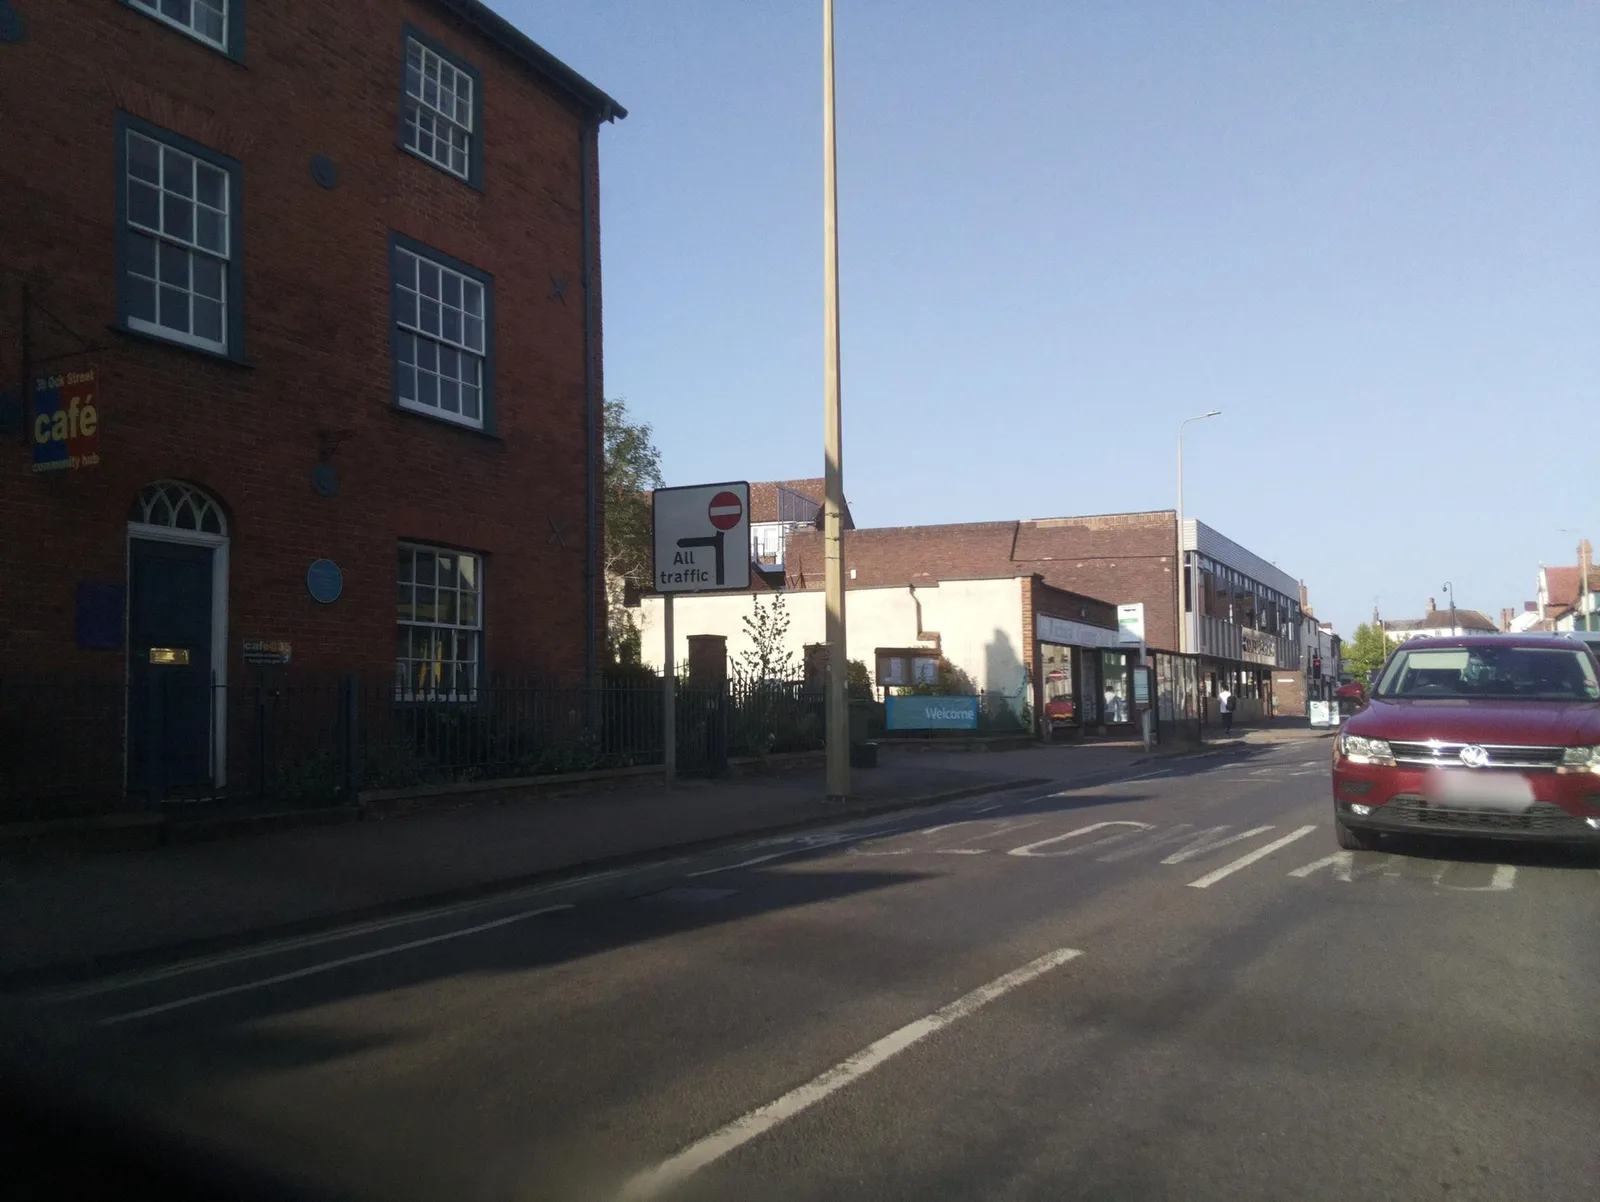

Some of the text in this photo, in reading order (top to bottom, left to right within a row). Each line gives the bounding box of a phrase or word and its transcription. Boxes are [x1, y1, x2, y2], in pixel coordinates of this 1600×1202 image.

[67, 368, 95, 385] Street
[34, 394, 97, 444] café
[32, 452, 100, 471] community hub
[673, 551, 695, 566] All
[660, 569, 709, 584] traffic
[925, 707, 975, 720] Welcome
